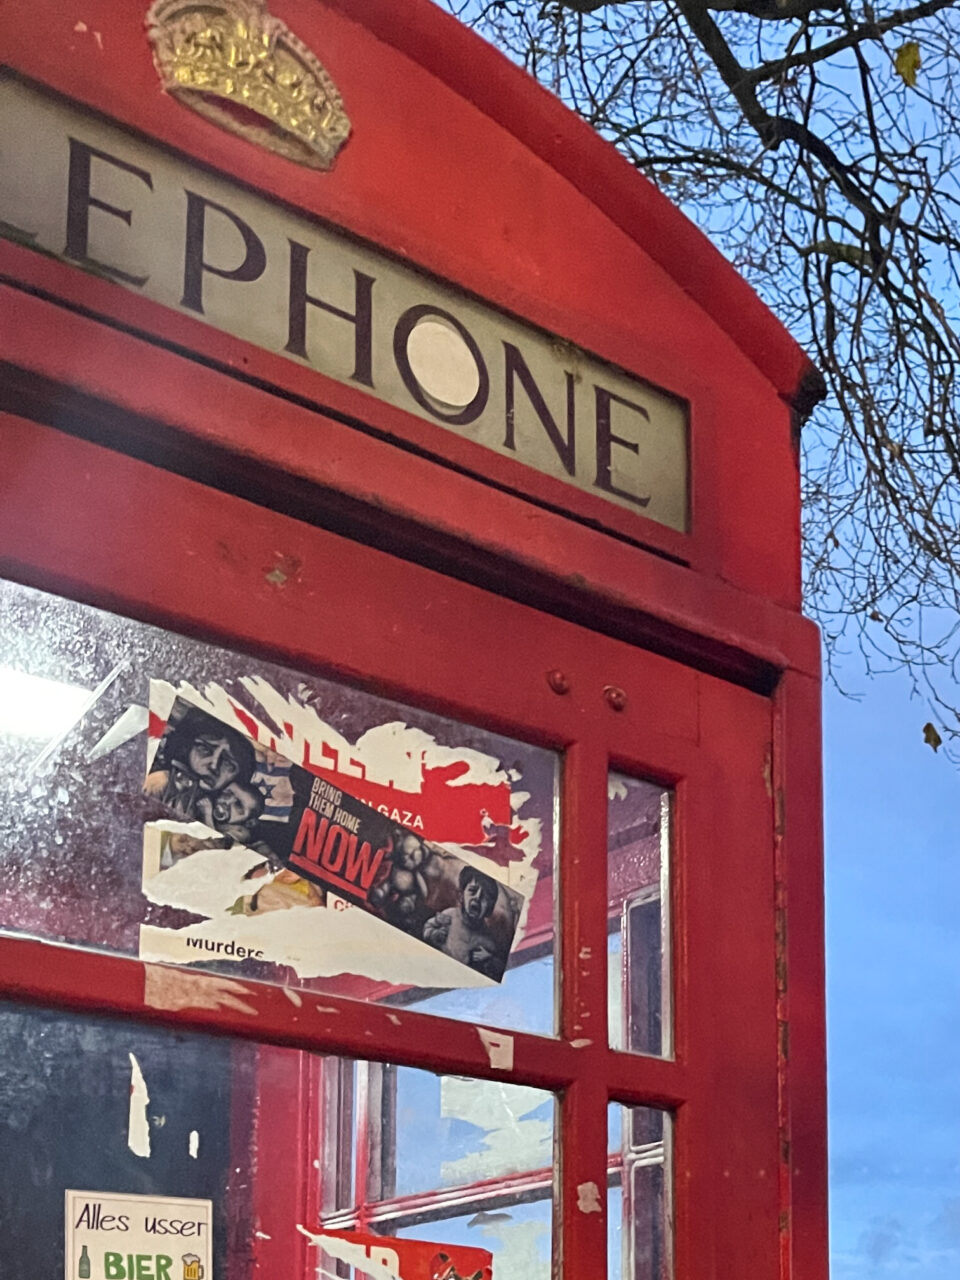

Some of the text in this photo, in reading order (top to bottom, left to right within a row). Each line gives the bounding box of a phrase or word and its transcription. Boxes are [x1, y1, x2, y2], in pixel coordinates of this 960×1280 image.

[0, 136, 653, 508] EPHONE
[308, 791, 335, 819] THEM
[333, 805, 360, 834] HOME
[311, 777, 343, 806] BRING
[292, 807, 385, 891] NOW
[75, 1203, 208, 1236] Alles usser
